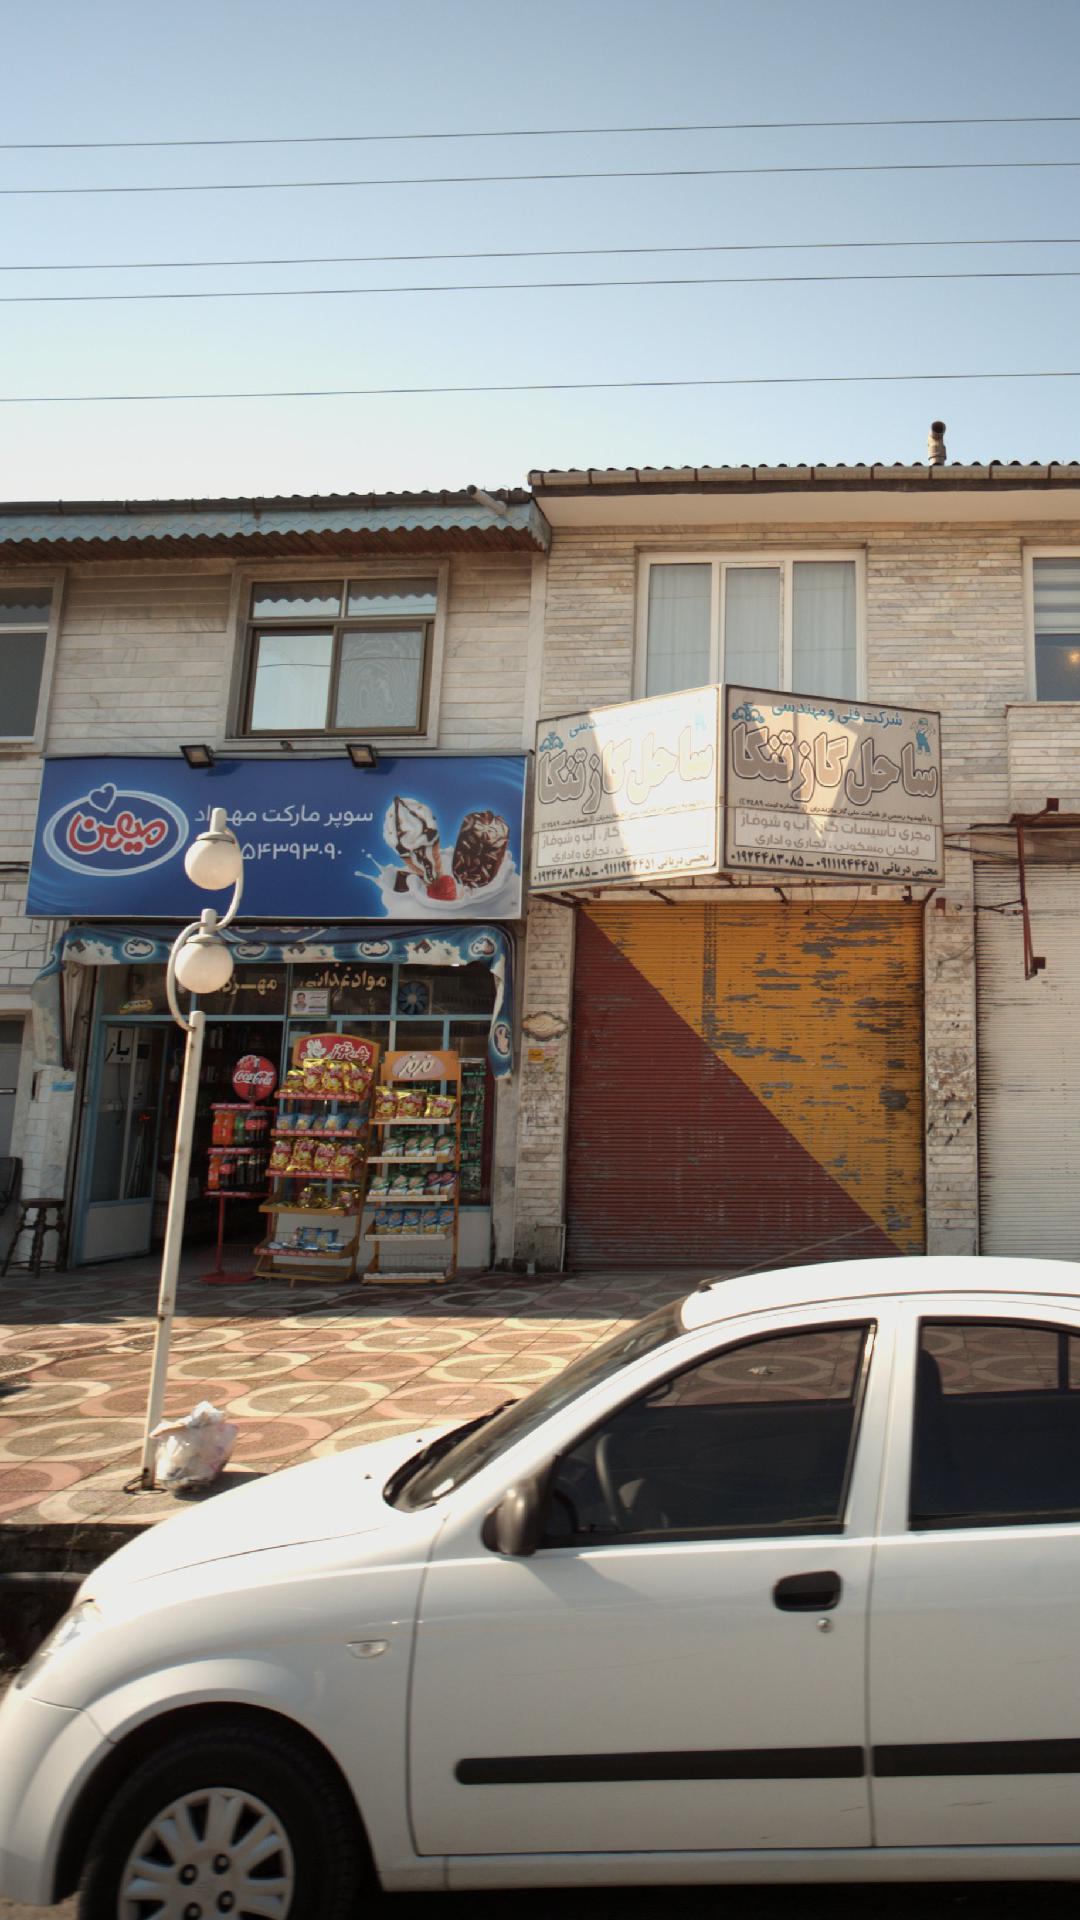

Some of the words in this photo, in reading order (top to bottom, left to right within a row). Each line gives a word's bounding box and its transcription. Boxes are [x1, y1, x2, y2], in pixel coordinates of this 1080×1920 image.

[771, 701, 826, 722] مهندسی
[864, 710, 903, 728] شرکت
[791, 731, 849, 804] گاز
[844, 737, 939, 806] ساحل
[261, 804, 321, 828] مارکت
[323, 810, 374, 829] سوپر
[66, 810, 168, 855] میهن
[351, 969, 388, 992] مواد
